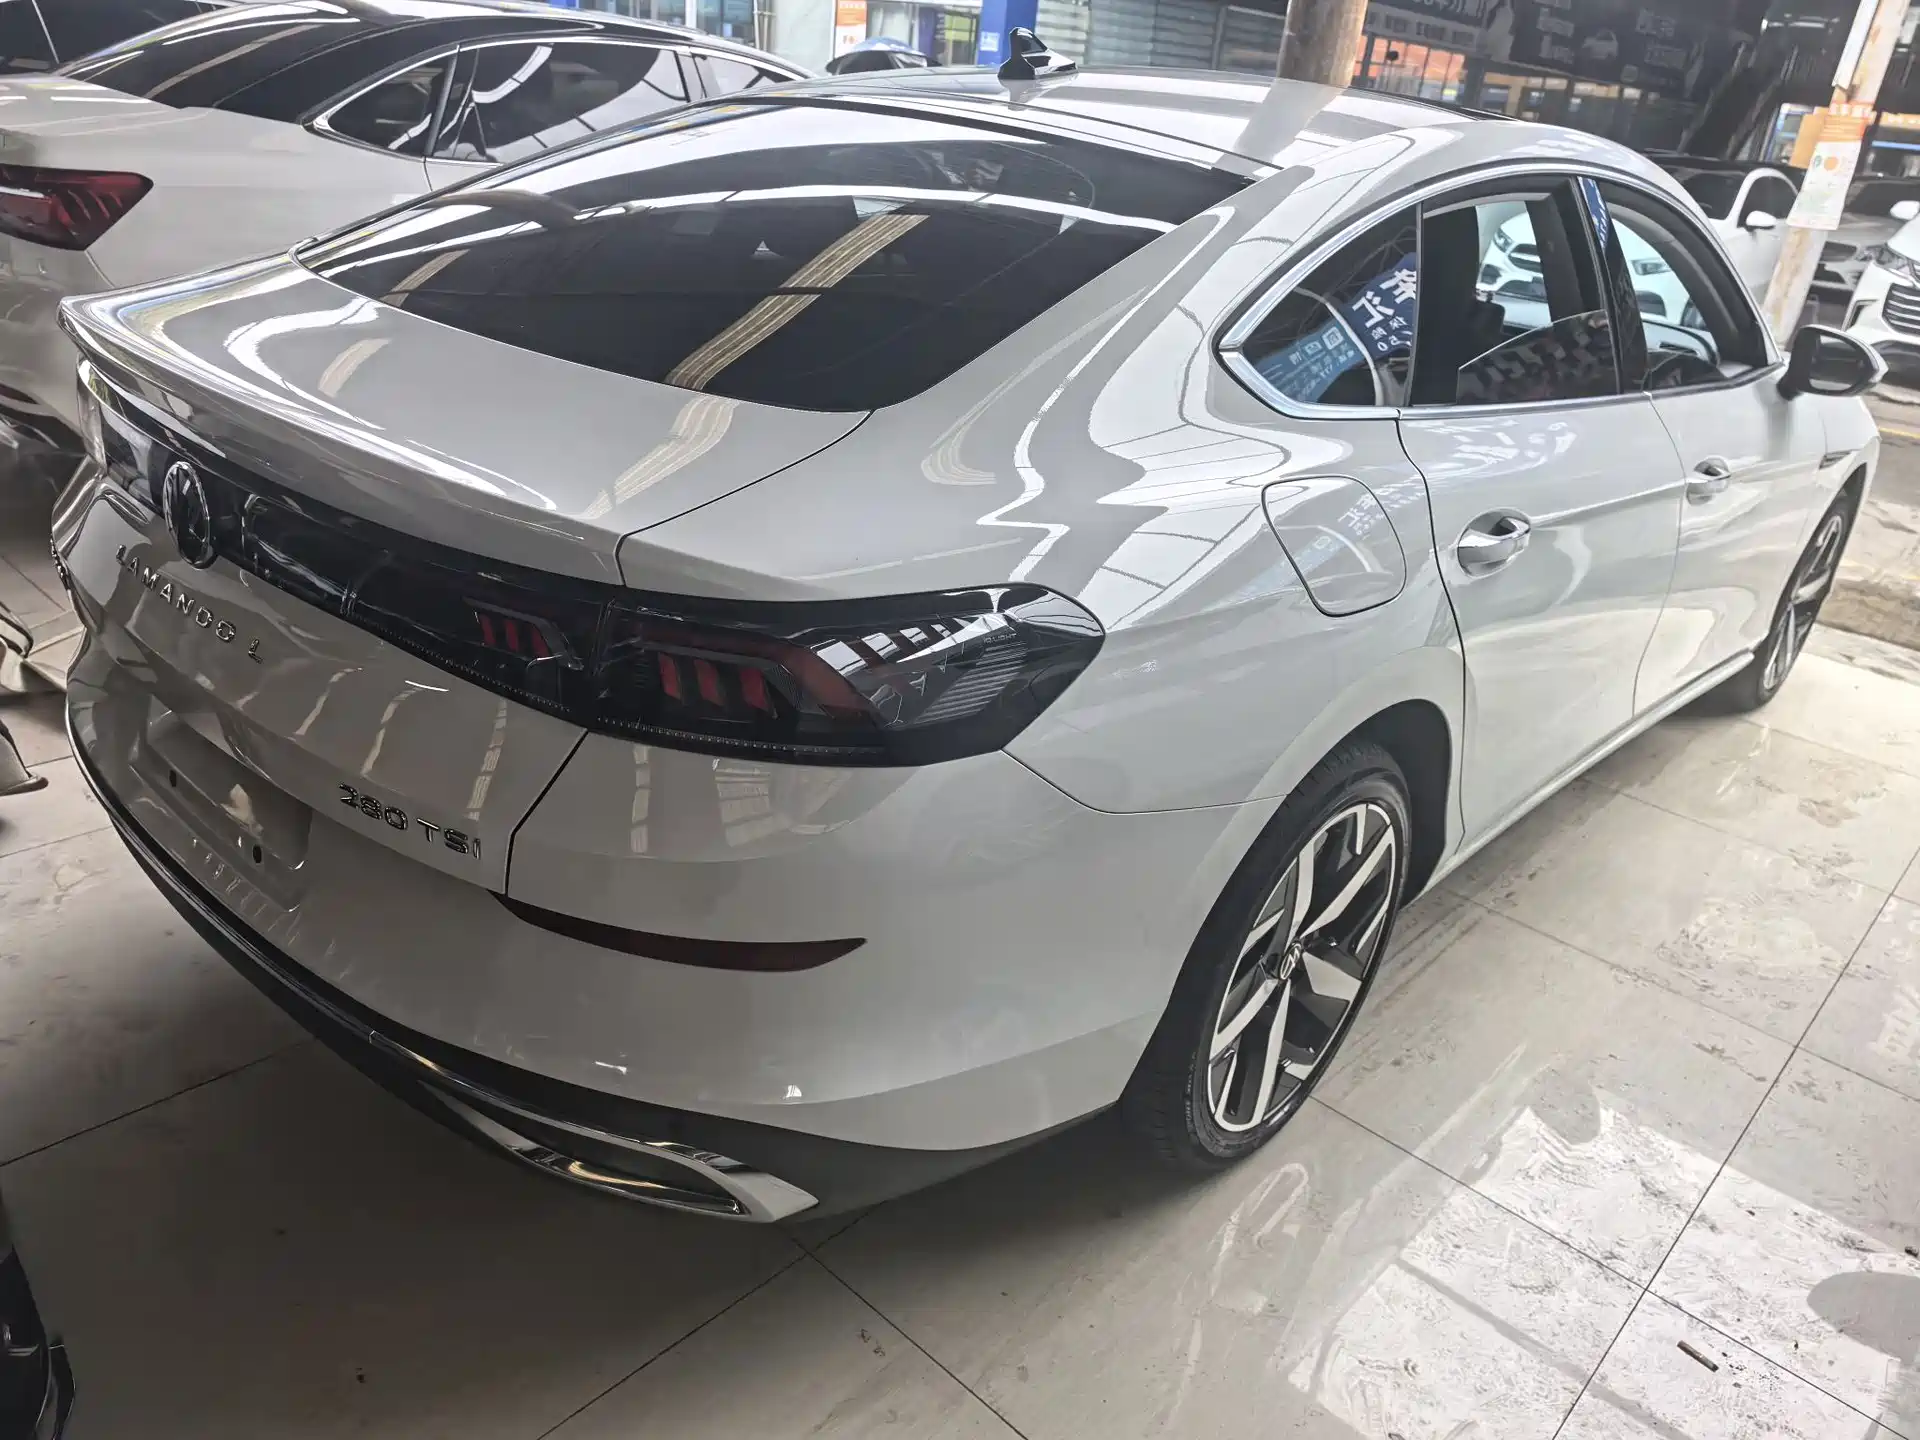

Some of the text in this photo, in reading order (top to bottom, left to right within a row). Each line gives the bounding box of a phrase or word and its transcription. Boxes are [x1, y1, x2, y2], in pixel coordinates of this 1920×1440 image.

[116, 544, 263, 664] LAMANDO L
[339, 782, 481, 860] 280 TSI
